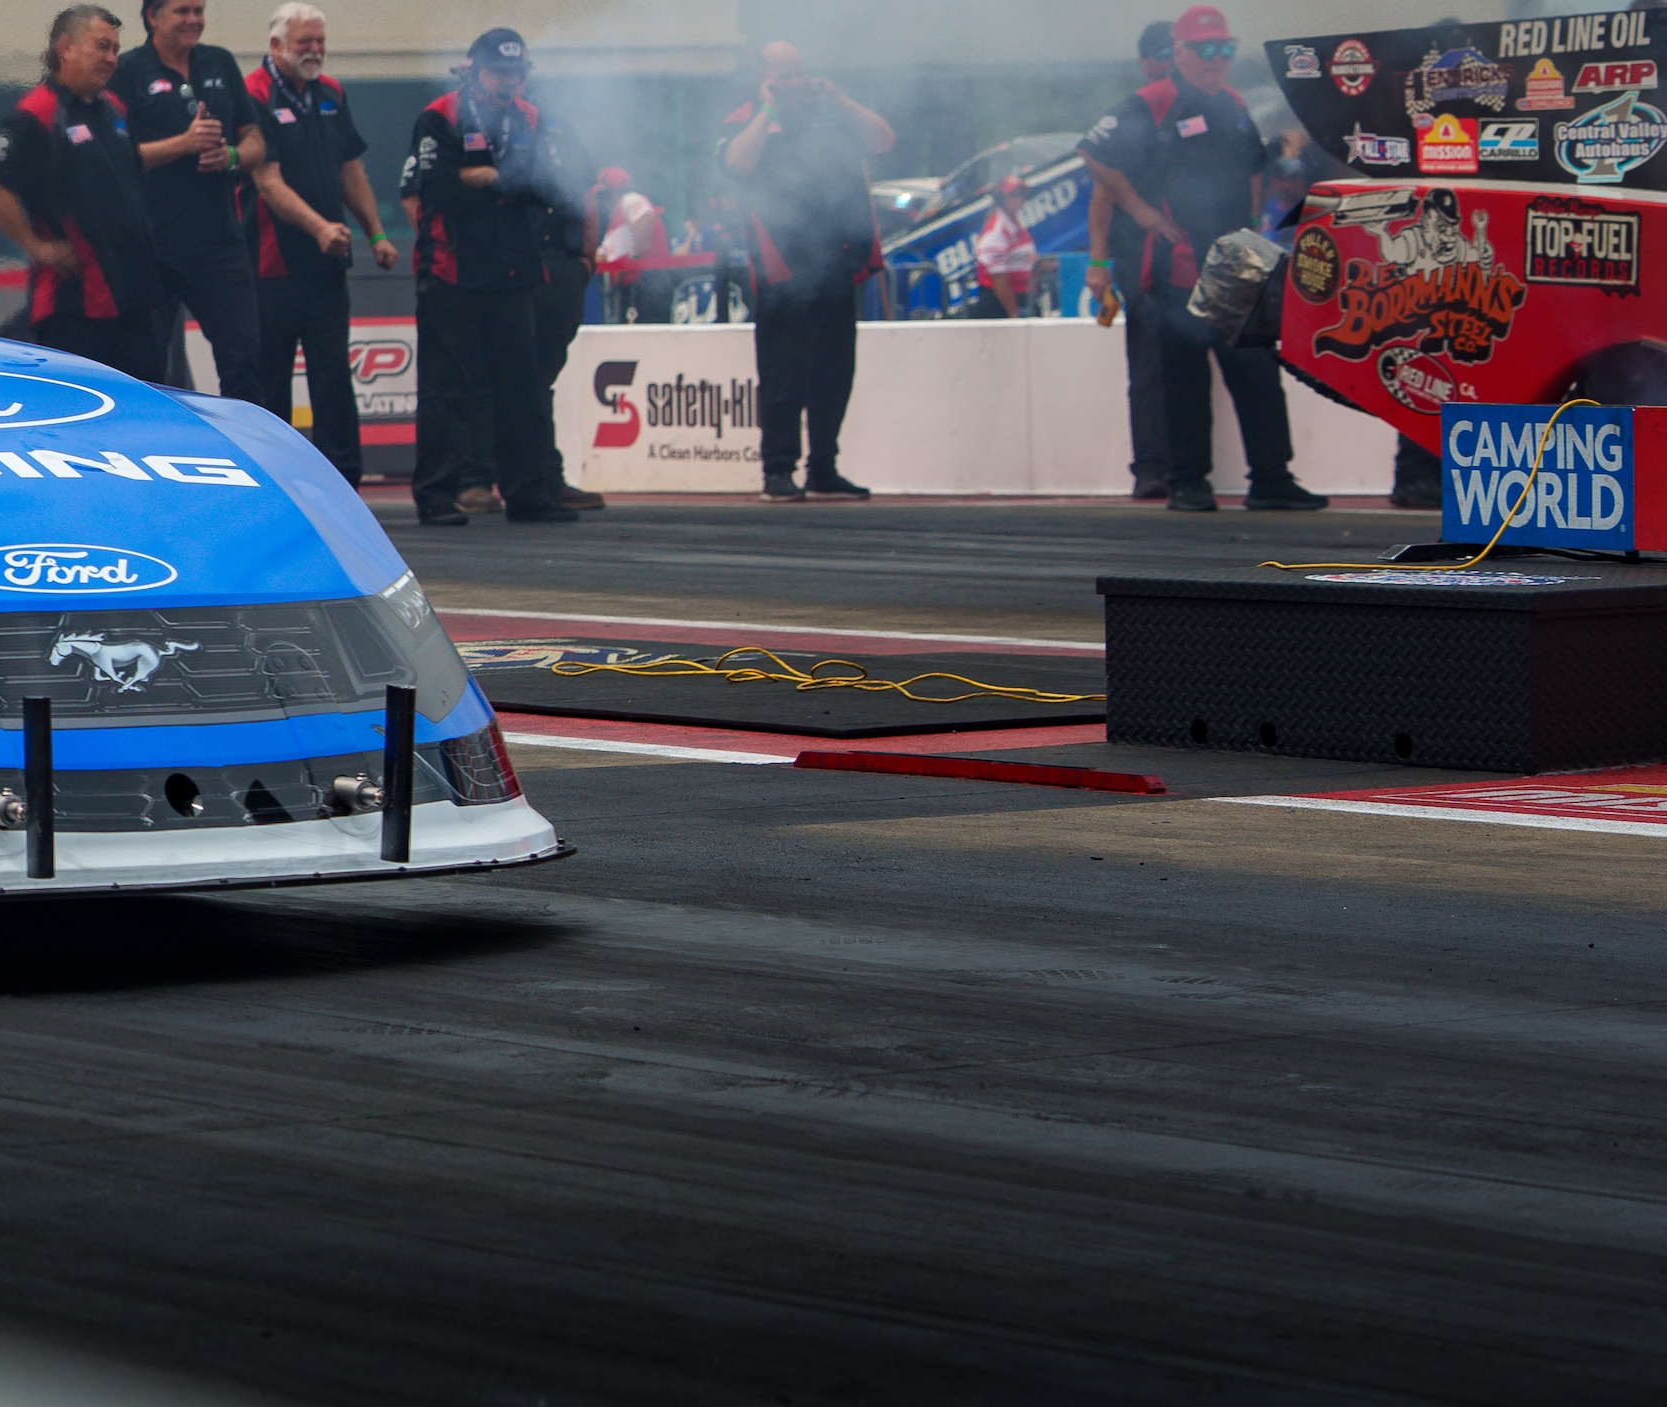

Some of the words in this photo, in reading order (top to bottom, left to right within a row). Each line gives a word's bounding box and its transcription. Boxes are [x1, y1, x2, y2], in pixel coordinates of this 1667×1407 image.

[1498, 20, 1548, 58] RED
[1551, 14, 1607, 54] LINE
[1610, 10, 1651, 48] OIL
[1576, 62, 1656, 87] ARP
[1557, 124, 1616, 141] Central
[1618, 122, 1667, 144] Valley
[1480, 148, 1538, 159] CARRILLO
[1575, 142, 1650, 160] Autohaus
[1532, 218, 1574, 258] TOP
[1581, 221, 1632, 261] FUEL
[1533, 257, 1629, 282] RECORDS
[1424, 309, 1493, 347] STEEL
[1402, 365, 1425, 389] RED
[1425, 374, 1454, 402] LINE
[647, 373, 761, 438] safety-kl
[647, 445, 657, 459] A
[659, 444, 691, 461] Clean
[694, 445, 740, 461] Harbors
[1449, 420, 1623, 472] CAMPING
[1450, 469, 1625, 531] WORLD
[2, 551, 139, 585] Ford
